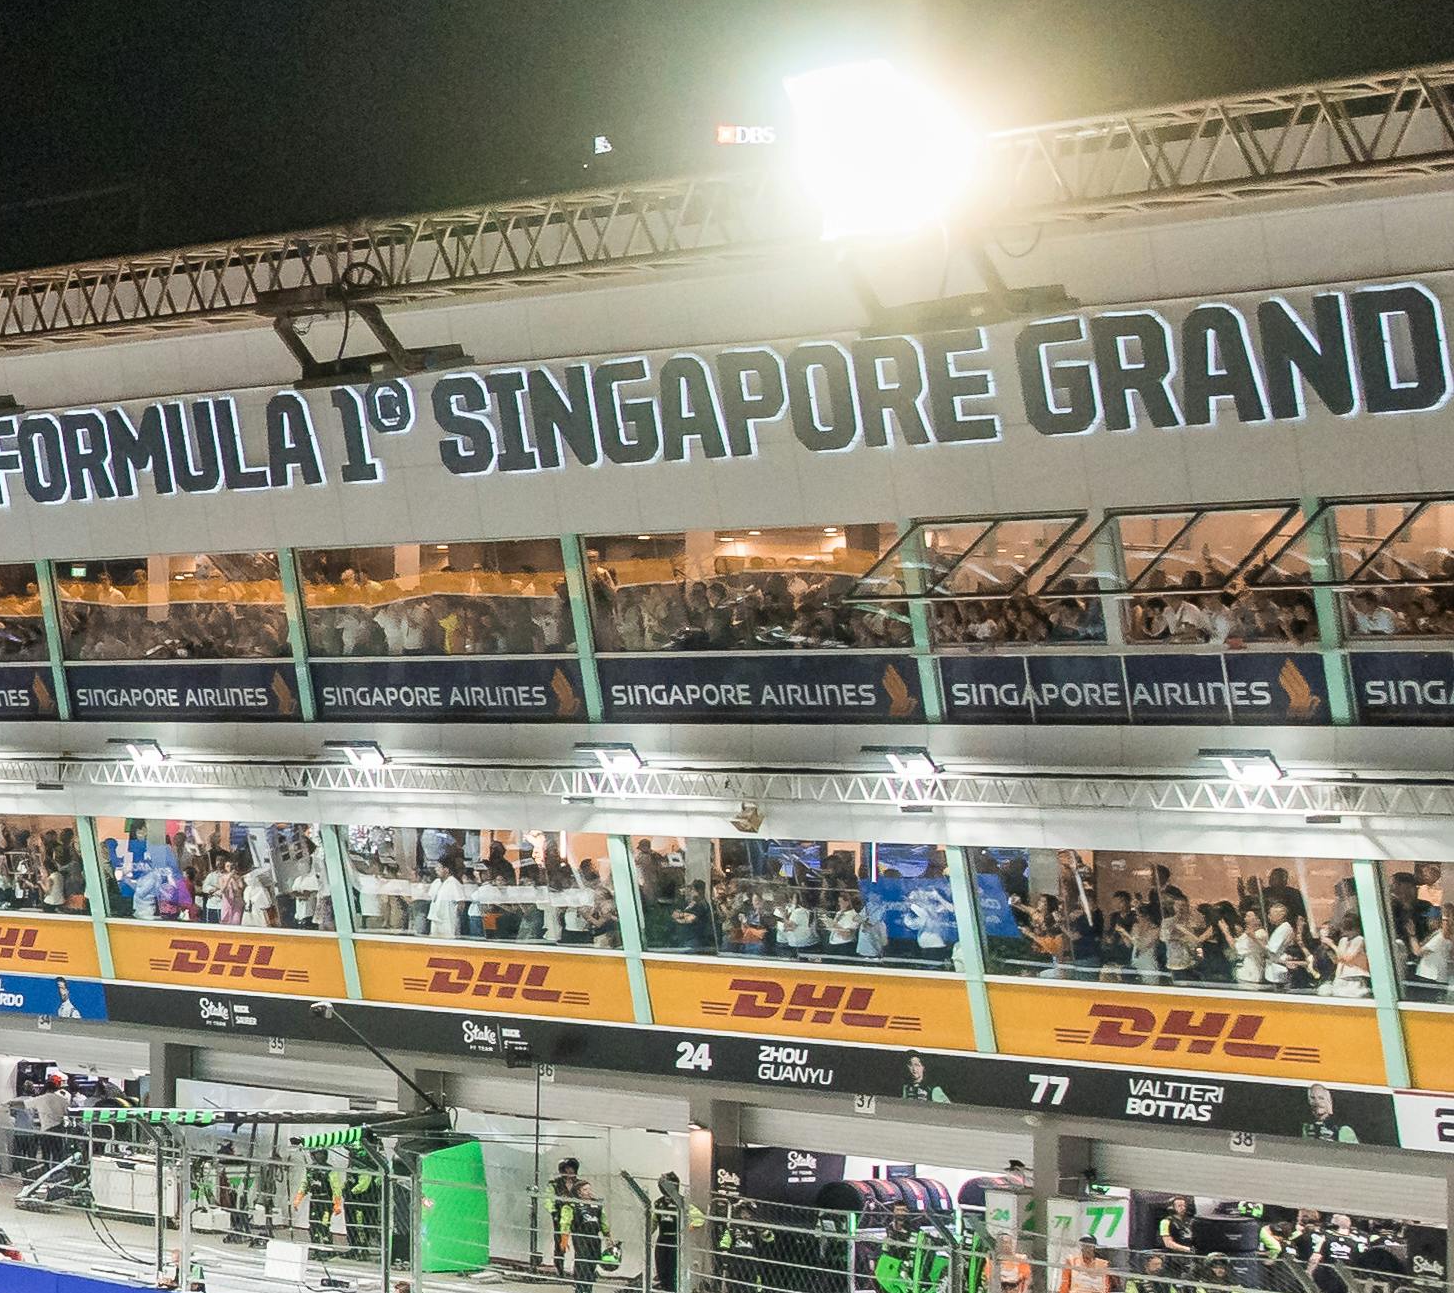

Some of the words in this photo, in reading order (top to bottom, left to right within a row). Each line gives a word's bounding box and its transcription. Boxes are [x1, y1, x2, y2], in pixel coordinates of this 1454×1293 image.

[430, 324, 1002, 478] SINGAPORE
[1014, 280, 1453, 437] GRAND
[76, 688, 180, 707] SINGAPORE
[186, 688, 268, 707] AIRLINES
[323, 686, 443, 707] SINGAPORE
[450, 686, 547, 707] AIRLINES
[611, 684, 752, 707] SINGAPORE
[760, 683, 877, 706] AIRLINES
[951, 682, 1121, 707] SINGAPORE
[1133, 681, 1272, 706] AIRLINES
[1365, 680, 1454, 706] SING
[166, 938, 286, 981] DHL
[426, 956, 563, 1003] DHL
[199, 997, 230, 1020] Stake
[728, 978, 889, 1029] DHL
[462, 1020, 497, 1045] Stake
[1086, 1002, 1283, 1060] DHL
[676, 1041, 713, 1071] 24
[758, 1044, 808, 1065] ZHOU
[758, 1062, 834, 1086] GUANYU
[856, 1092, 874, 1109] 37
[1028, 1073, 1071, 1106] 77
[1128, 1077, 1225, 1105] VALTTERI
[1125, 1096, 1213, 1123] BOTTAS
[1086, 1206, 1124, 1238] 77
